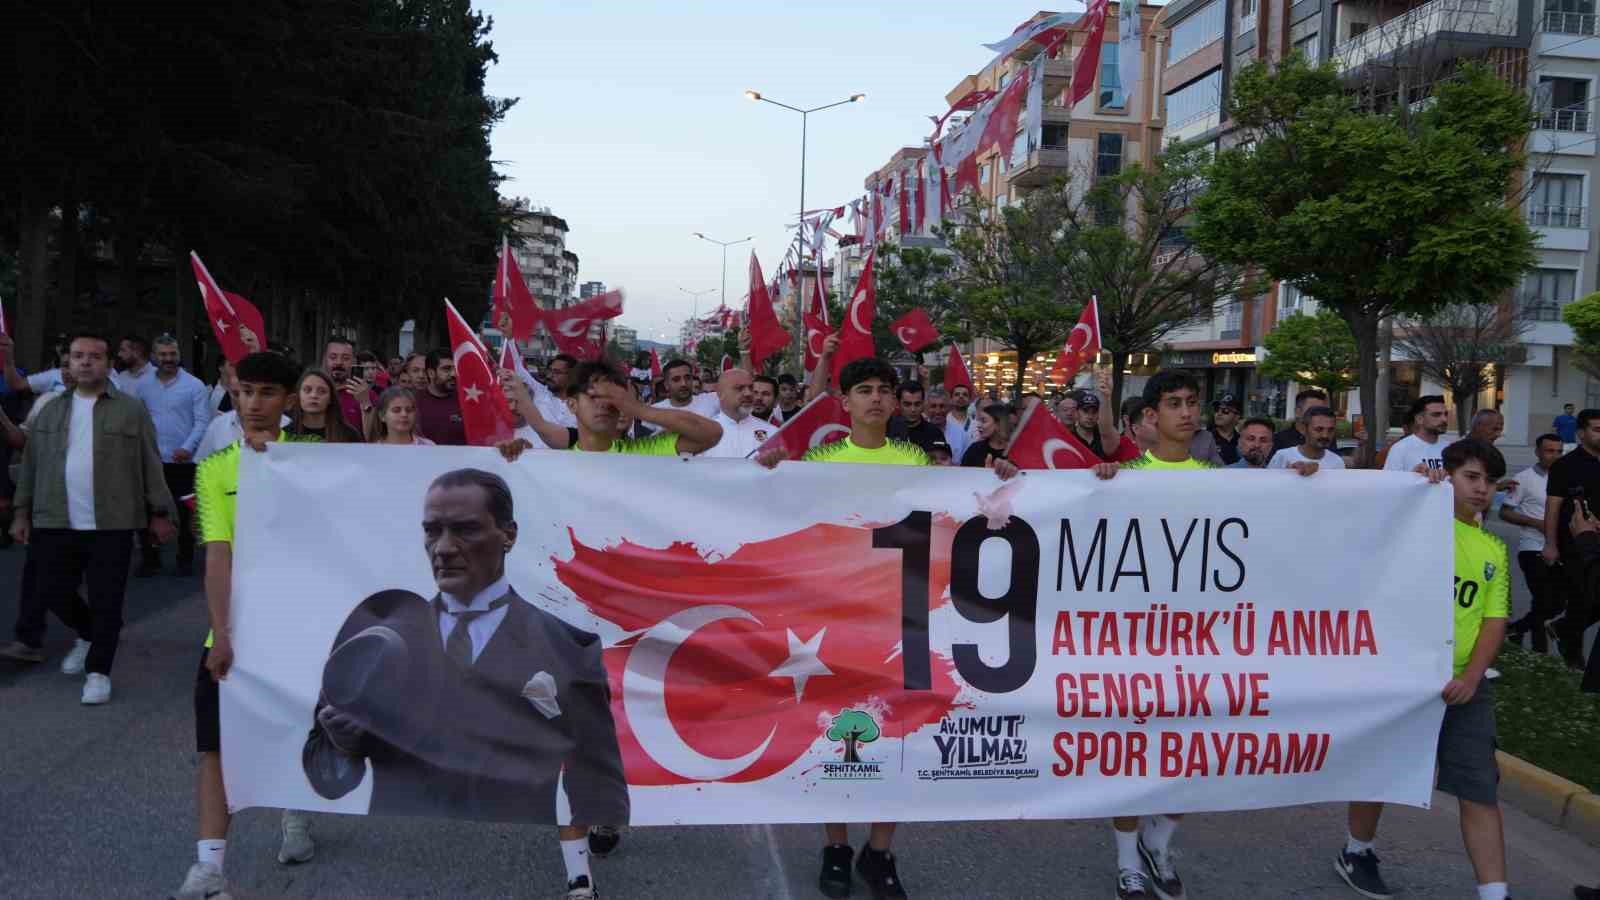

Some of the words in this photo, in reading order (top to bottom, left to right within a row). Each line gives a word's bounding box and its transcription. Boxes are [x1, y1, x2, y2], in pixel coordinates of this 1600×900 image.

[872, 511, 1040, 693] 19
[1056, 518, 1249, 592] MAYIS
[1052, 603, 1255, 656] ATATÜRK'Ü
[1267, 609, 1378, 655] ANMA
[1055, 664, 1211, 724] GENÇLİK
[1222, 672, 1270, 717] VE
[933, 735, 1023, 765] YILMAZ
[1052, 731, 1147, 777] SPOR
[1160, 732, 1330, 778] BAYRAMI
